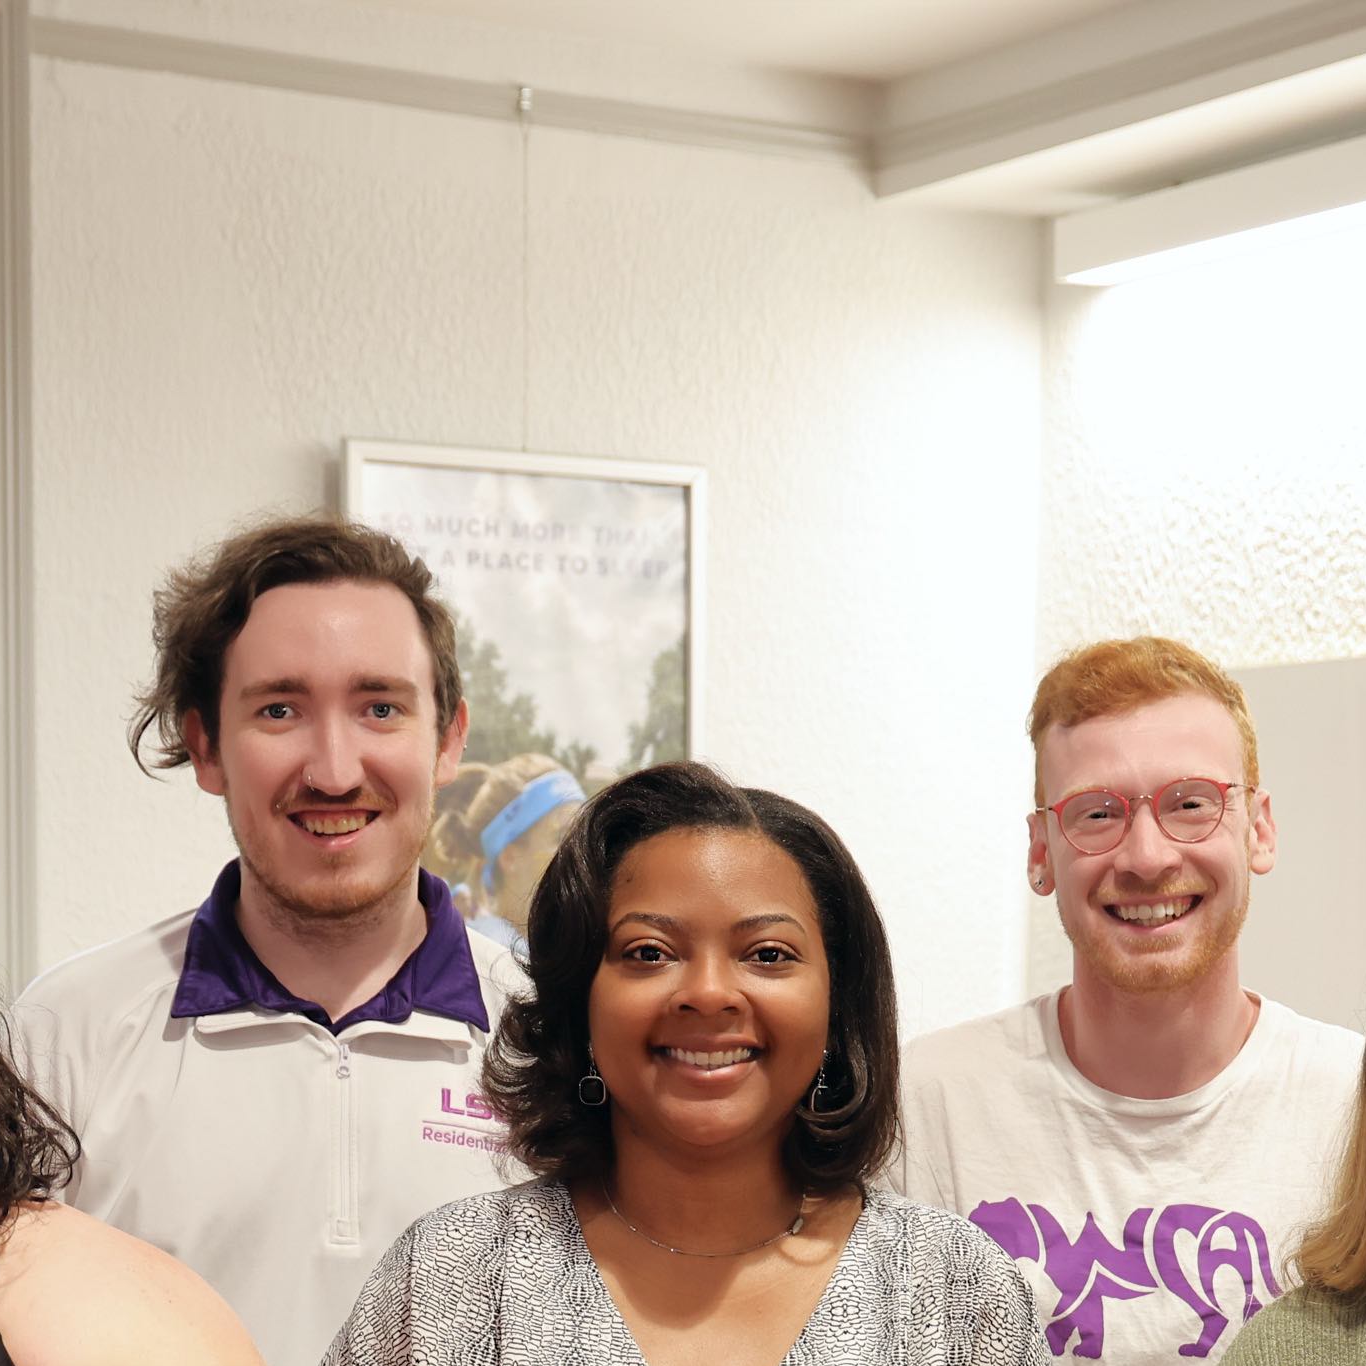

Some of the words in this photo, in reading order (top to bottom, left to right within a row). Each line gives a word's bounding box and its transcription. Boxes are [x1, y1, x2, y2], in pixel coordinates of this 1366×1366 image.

[424, 515, 501, 540] MUCH
[466, 549, 544, 573] PLACE
[555, 553, 589, 577] TO
[596, 557, 670, 580] SEP
